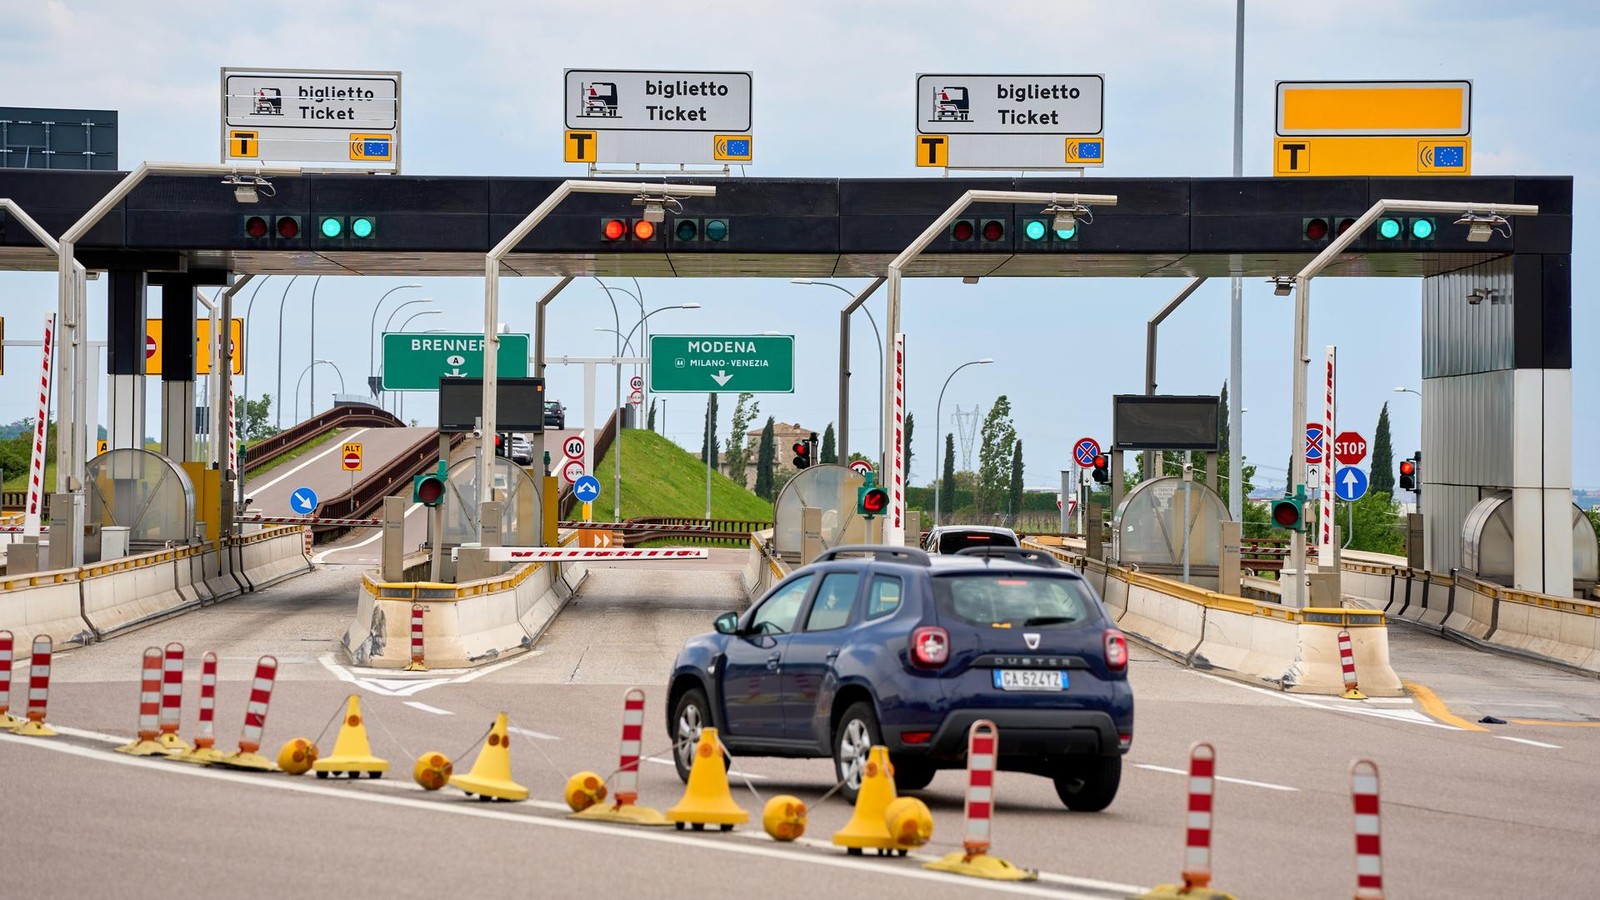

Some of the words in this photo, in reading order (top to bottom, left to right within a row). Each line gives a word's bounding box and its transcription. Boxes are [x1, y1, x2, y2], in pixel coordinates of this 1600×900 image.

[298, 86, 374, 103] biglietto
[646, 80, 728, 98] biglietto
[997, 84, 1080, 102] biglietto
[299, 106, 355, 120] Ticket
[646, 105, 707, 121] Ticket
[998, 109, 1059, 125] Ticket
[234, 133, 254, 155] T
[569, 133, 592, 159] T
[921, 138, 944, 164] T
[1282, 143, 1306, 170] T
[411, 339, 500, 352] BRENNER
[688, 341, 757, 353] MODENA
[452, 357, 460, 365] A
[567, 442, 582, 454] 40
[1334, 441, 1366, 455] STOP
[994, 657, 1070, 665] DUSTER
